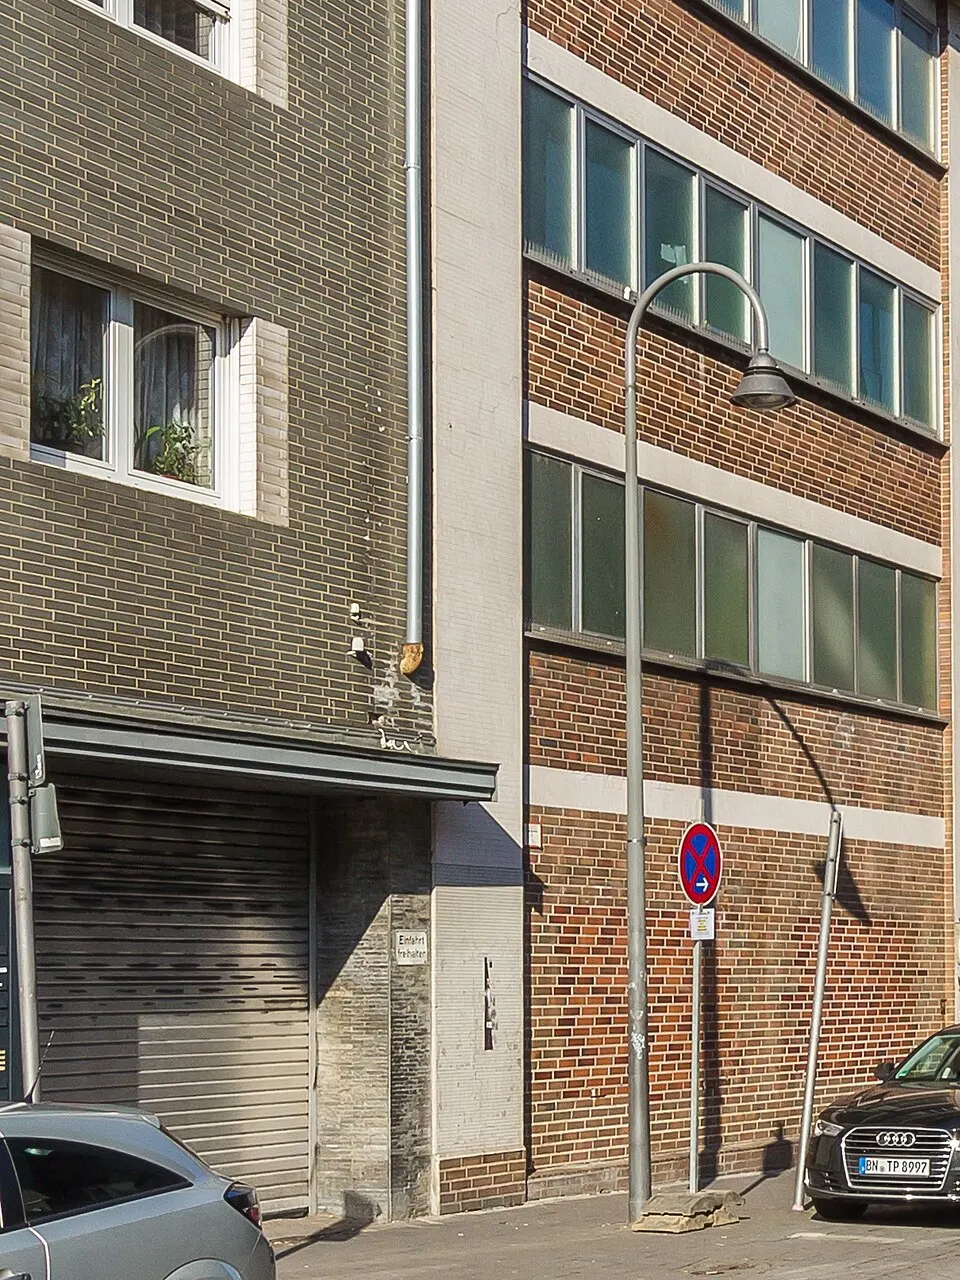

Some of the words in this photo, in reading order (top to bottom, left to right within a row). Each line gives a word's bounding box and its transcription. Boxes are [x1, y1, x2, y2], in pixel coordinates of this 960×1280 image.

[866, 1160, 878, 1171] BN
[887, 1161, 899, 1172] TP
[902, 1161, 927, 1173] 8997
